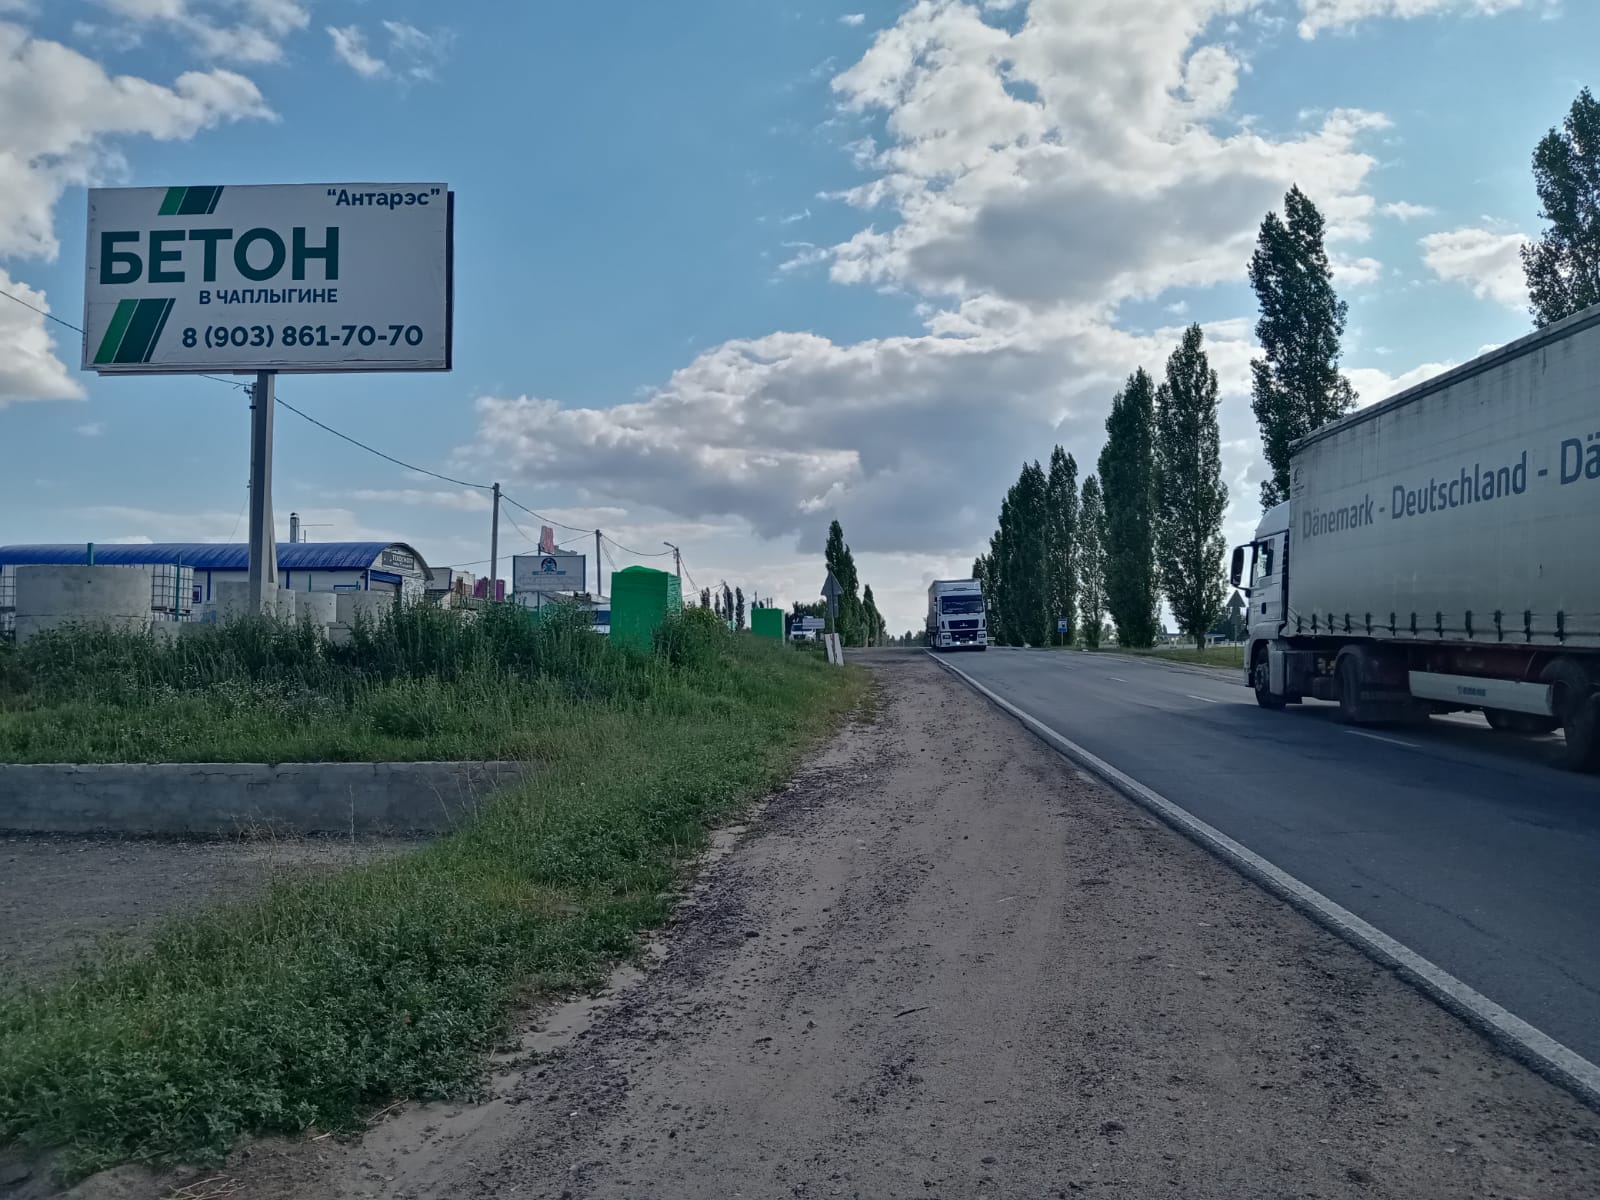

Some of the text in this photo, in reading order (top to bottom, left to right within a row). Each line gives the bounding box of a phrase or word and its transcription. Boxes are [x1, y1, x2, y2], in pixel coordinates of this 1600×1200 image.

[100, 226, 340, 284] БЕТОН
[199, 288, 338, 304] В ЧАПЛЫГИНЕ
[182, 325, 424, 349] 8 (903) 861-70-70
[1303, 494, 1374, 538] Dänemark
[1392, 451, 1527, 519] Deutschland
